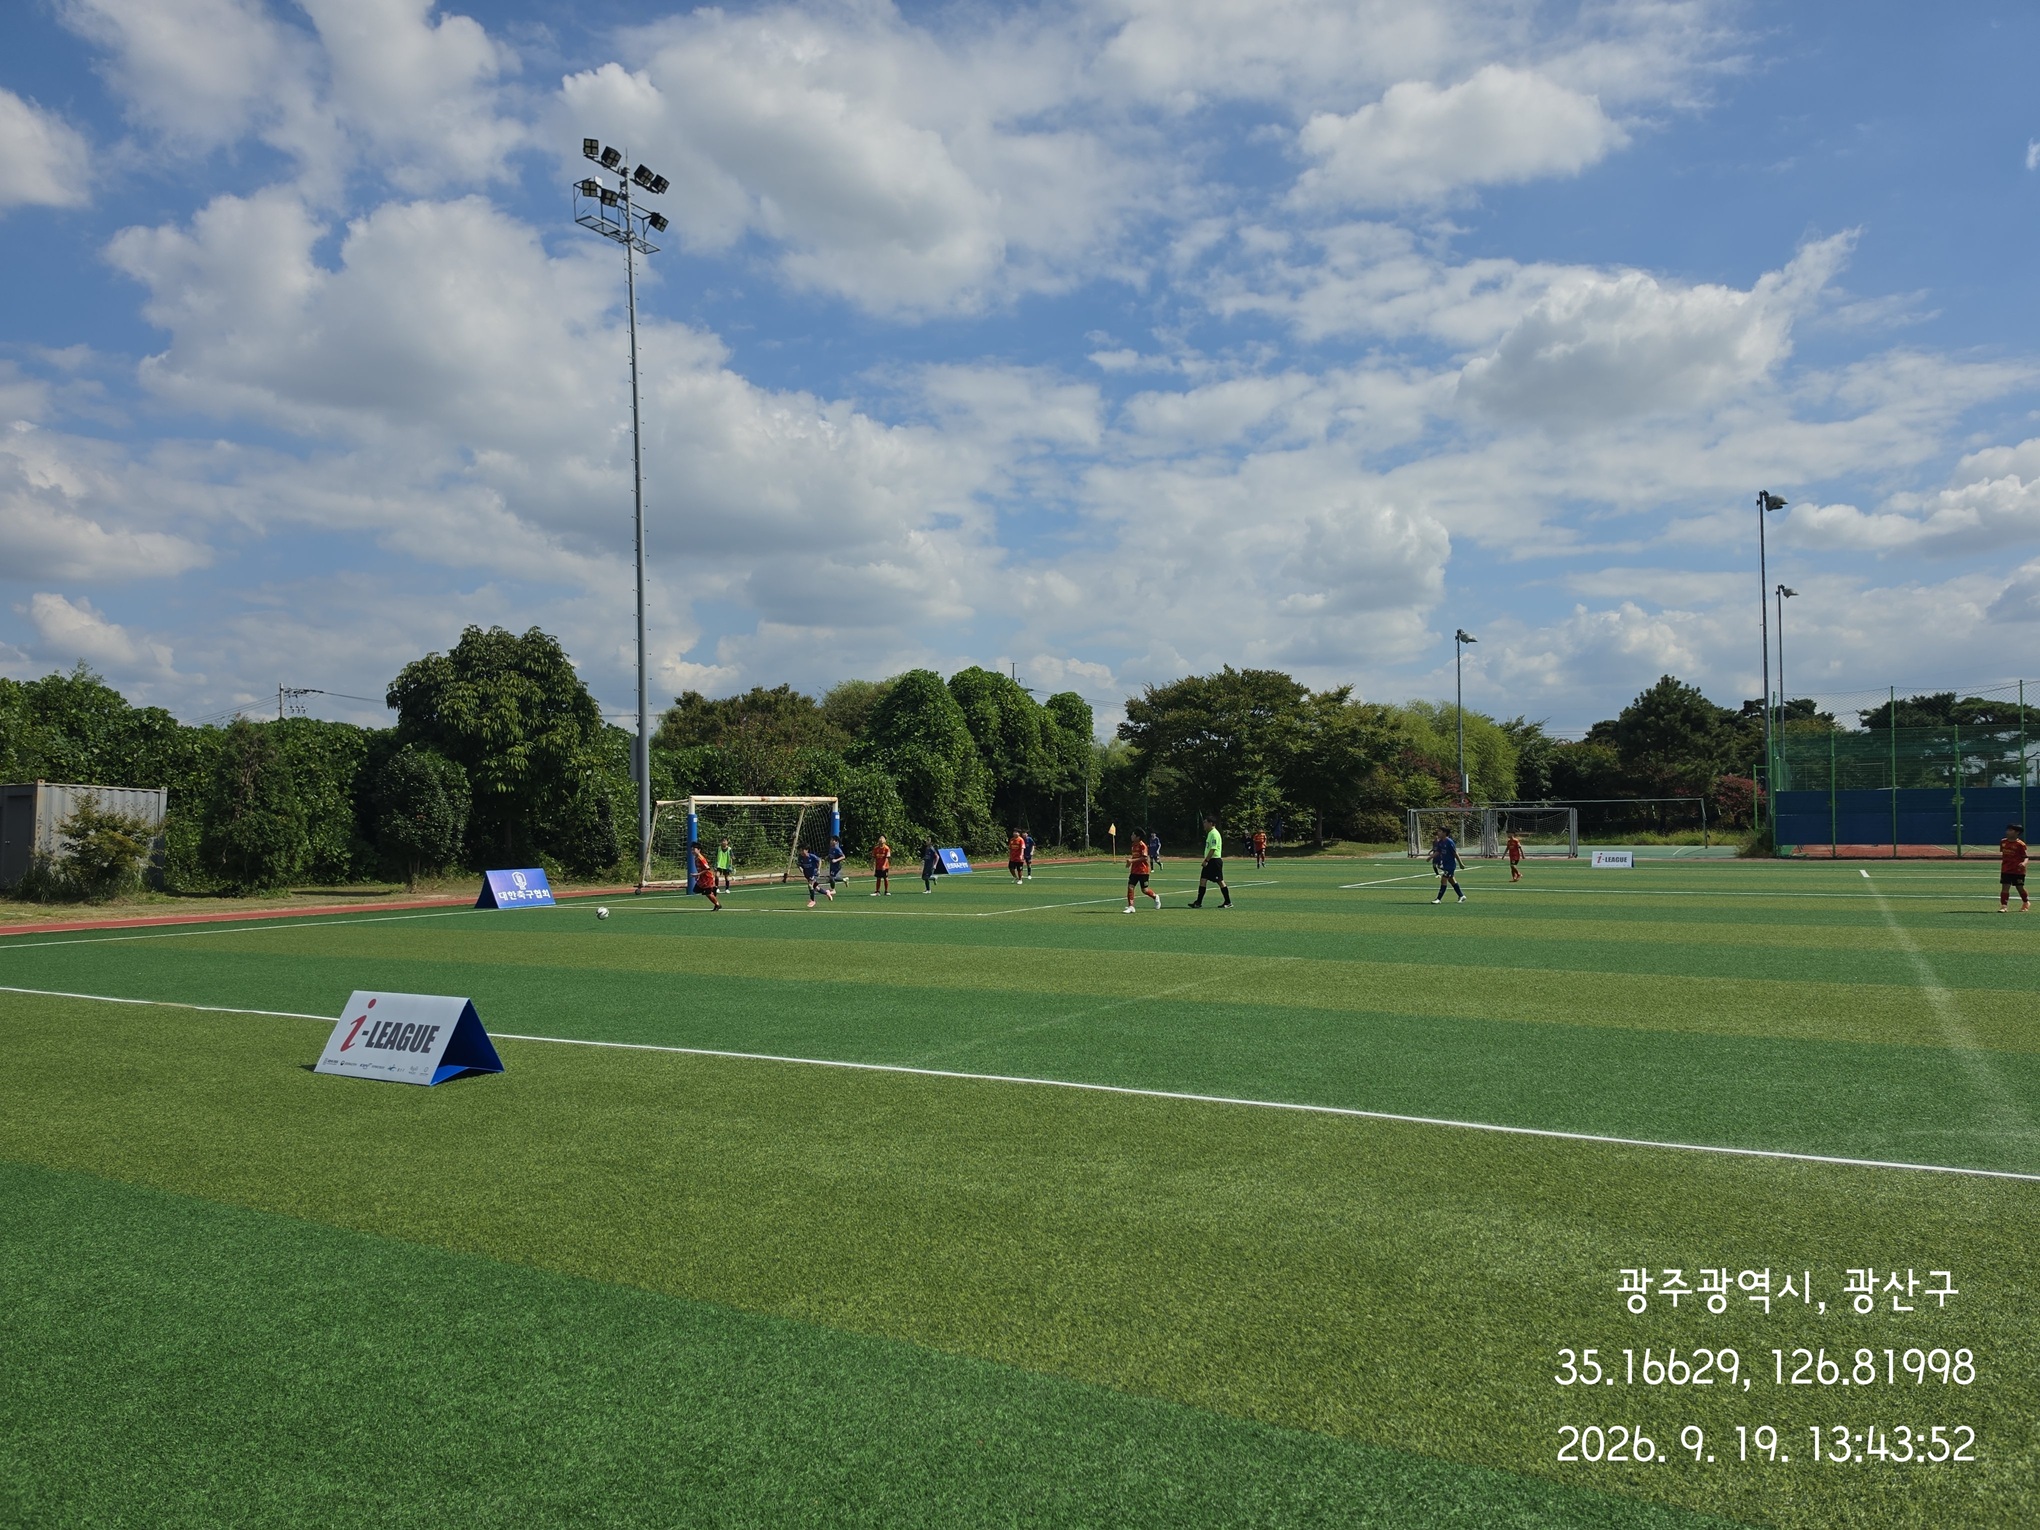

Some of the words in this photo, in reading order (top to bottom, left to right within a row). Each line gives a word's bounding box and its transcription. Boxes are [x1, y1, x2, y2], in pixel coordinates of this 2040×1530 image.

[1597, 852, 1627, 864] i-LEAGUE
[498, 889, 551, 901] 대한축구협회
[340, 998, 440, 1053] i-LEAGUE
